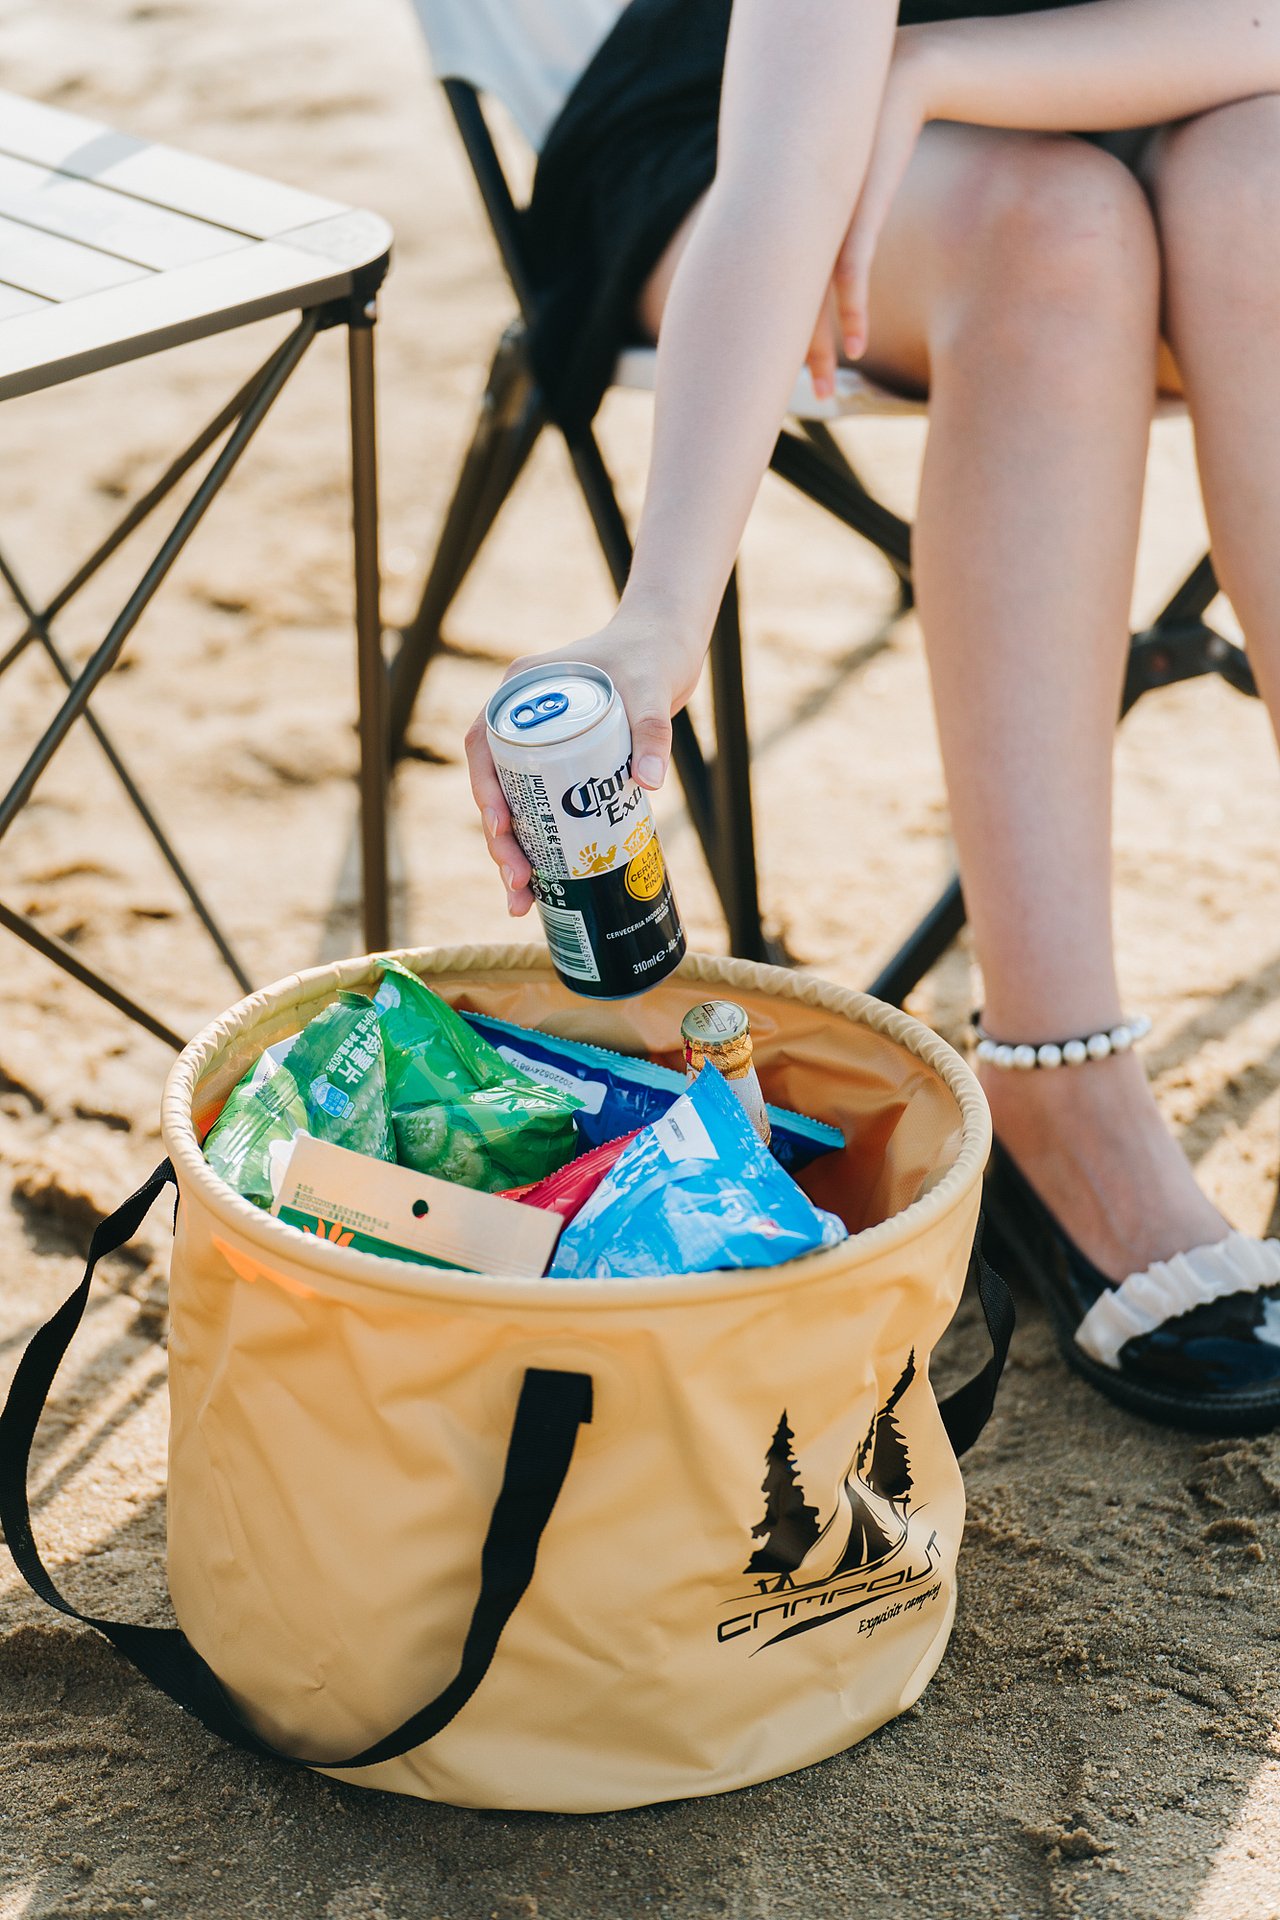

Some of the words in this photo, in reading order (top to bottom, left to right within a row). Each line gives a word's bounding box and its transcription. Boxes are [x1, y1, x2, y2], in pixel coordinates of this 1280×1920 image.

[641, 851, 652, 864] LA
[645, 873, 661, 892] FINA
[606, 920, 645, 940] CERVECERIA
[717, 1531, 941, 1642] CAMPOUT
[857, 1603, 903, 1639] Exquisite
[904, 1581, 942, 1612] camping
